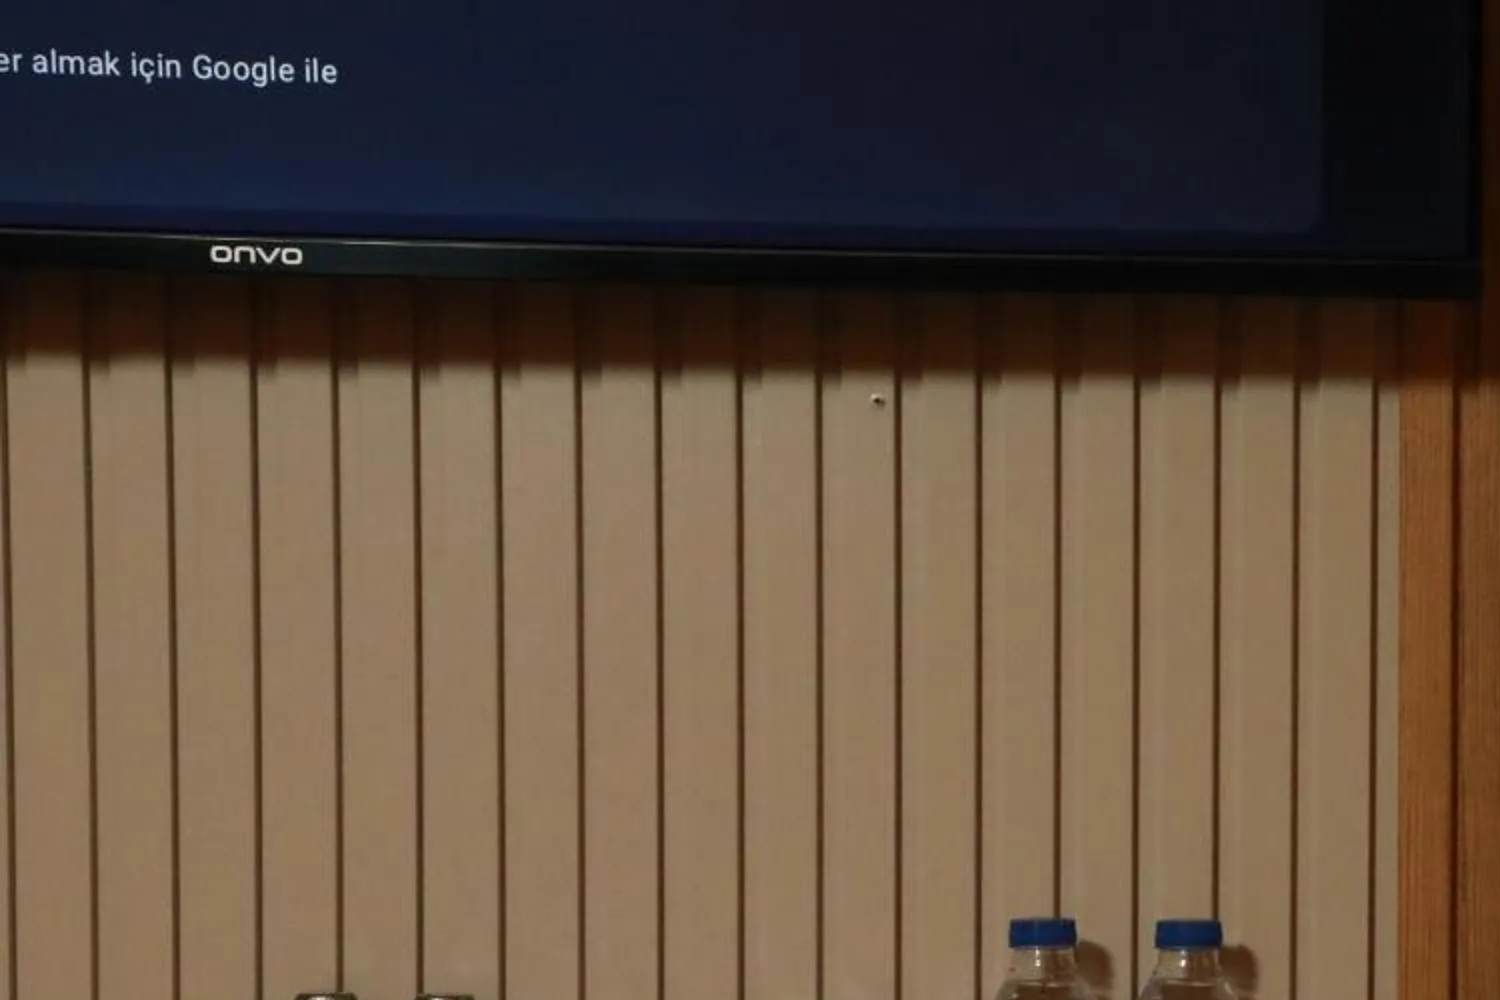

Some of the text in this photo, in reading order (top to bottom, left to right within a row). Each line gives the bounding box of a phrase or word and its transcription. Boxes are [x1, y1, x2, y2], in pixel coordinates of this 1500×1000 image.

[0, 47, 338, 88] er almak için Google ile
